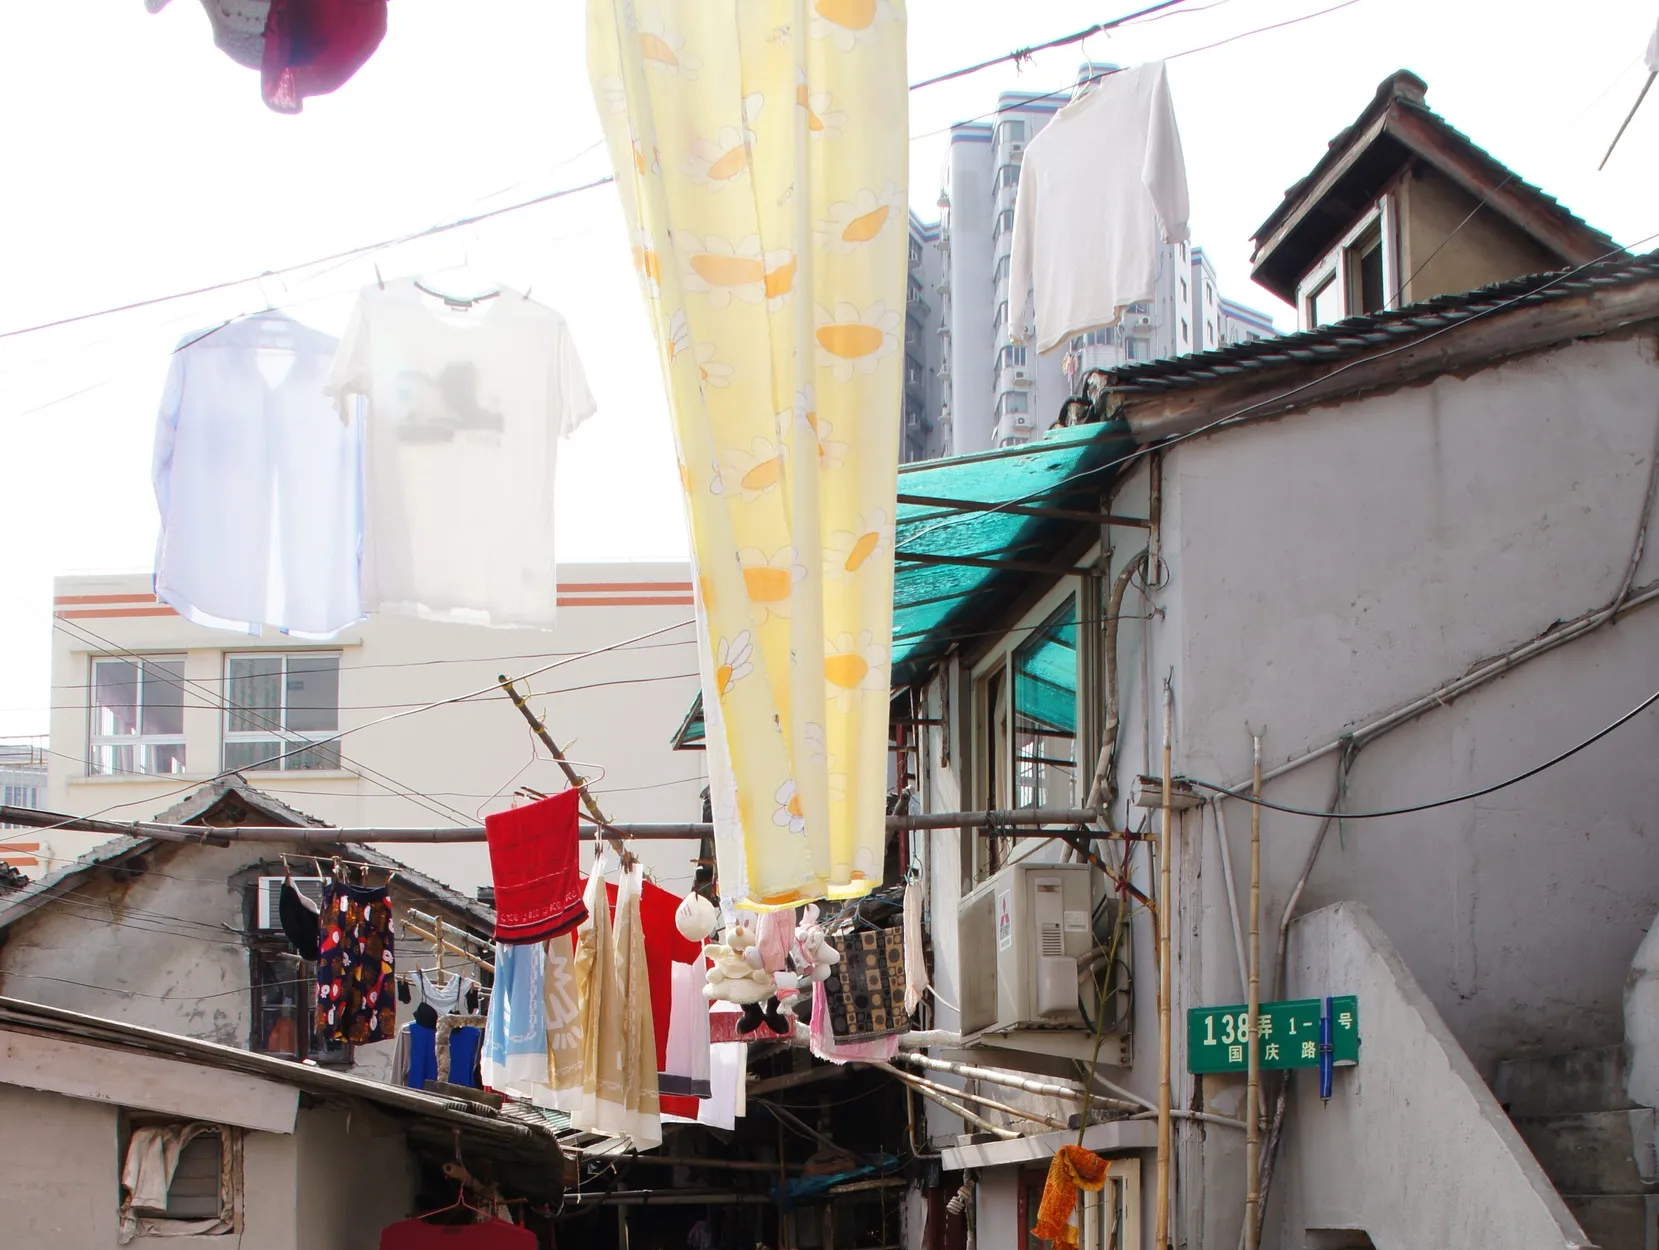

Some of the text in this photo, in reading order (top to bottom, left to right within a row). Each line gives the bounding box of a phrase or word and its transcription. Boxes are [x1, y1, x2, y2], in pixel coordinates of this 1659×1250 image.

[1203, 1012, 1353, 1046] 138弄 1-号
[1228, 1041, 1317, 1063] 国庆路
